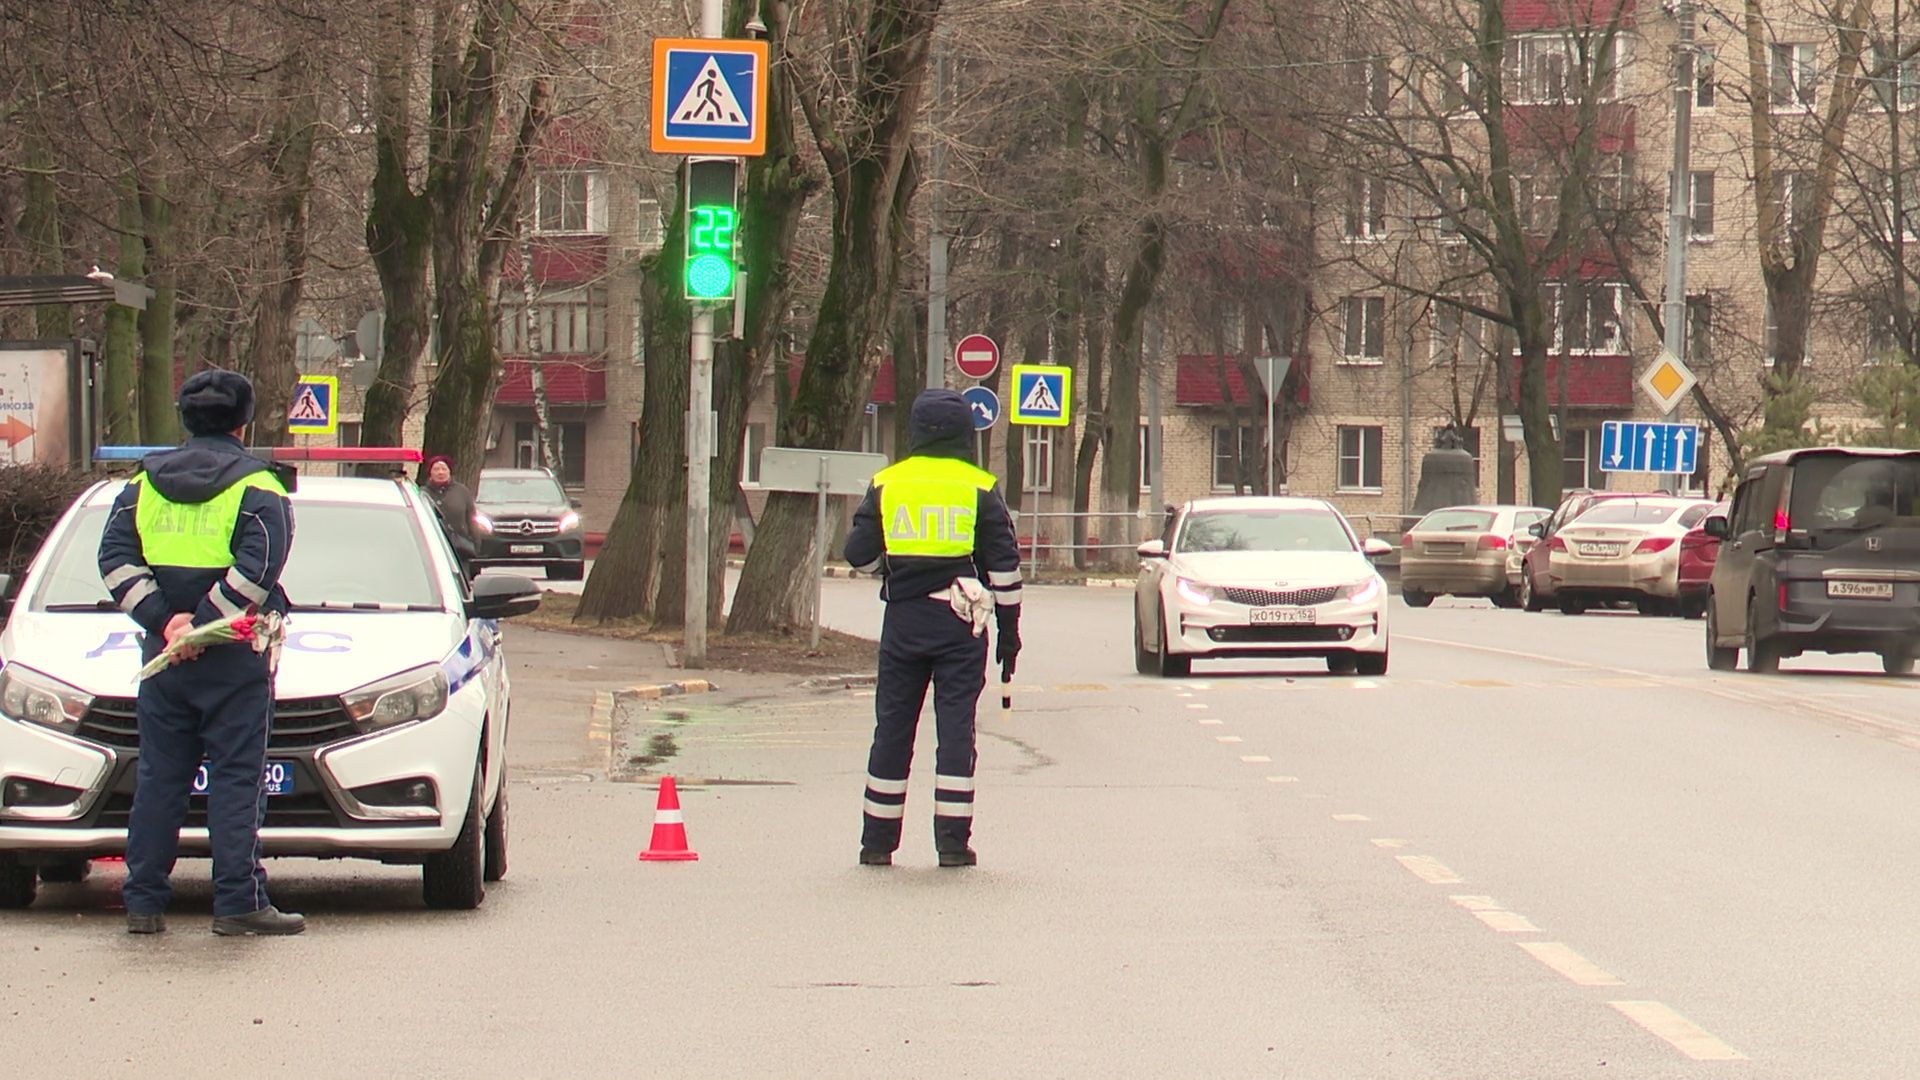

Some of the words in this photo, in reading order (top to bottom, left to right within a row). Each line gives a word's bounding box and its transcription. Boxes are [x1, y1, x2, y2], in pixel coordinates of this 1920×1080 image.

[695, 209, 732, 248] 22
[152, 503, 222, 537] ДПС
[889, 505, 971, 541] ДПС
